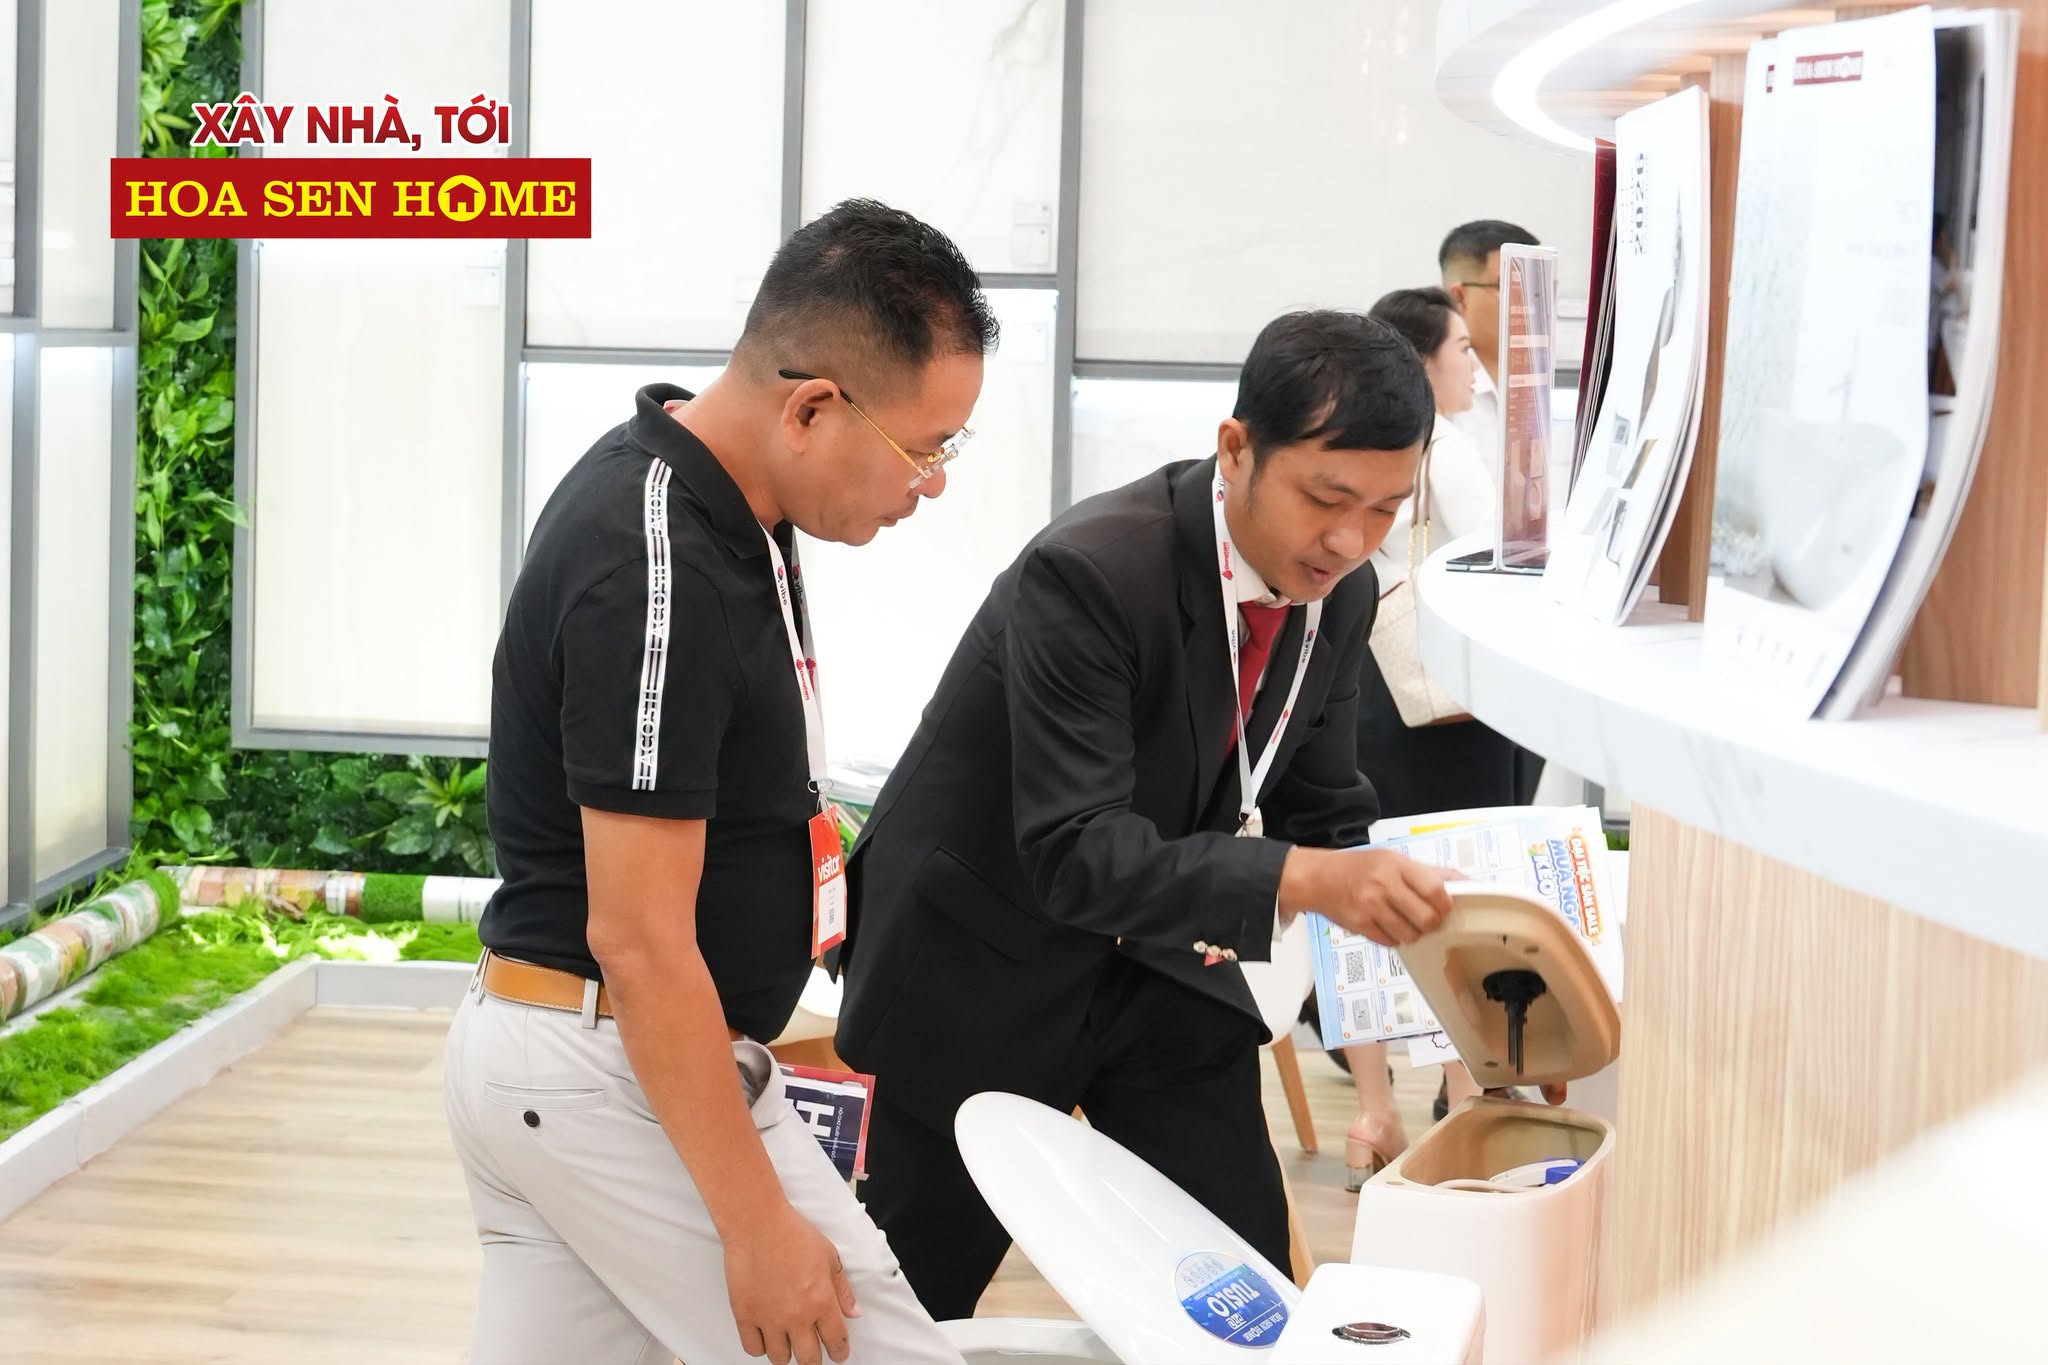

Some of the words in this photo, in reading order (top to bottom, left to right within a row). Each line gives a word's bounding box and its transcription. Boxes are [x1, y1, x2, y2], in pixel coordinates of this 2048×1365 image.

[1549, 840, 1573, 881] MUA
[1561, 885, 1580, 930] NGA
[1206, 1279, 1261, 1317] TUSLO
